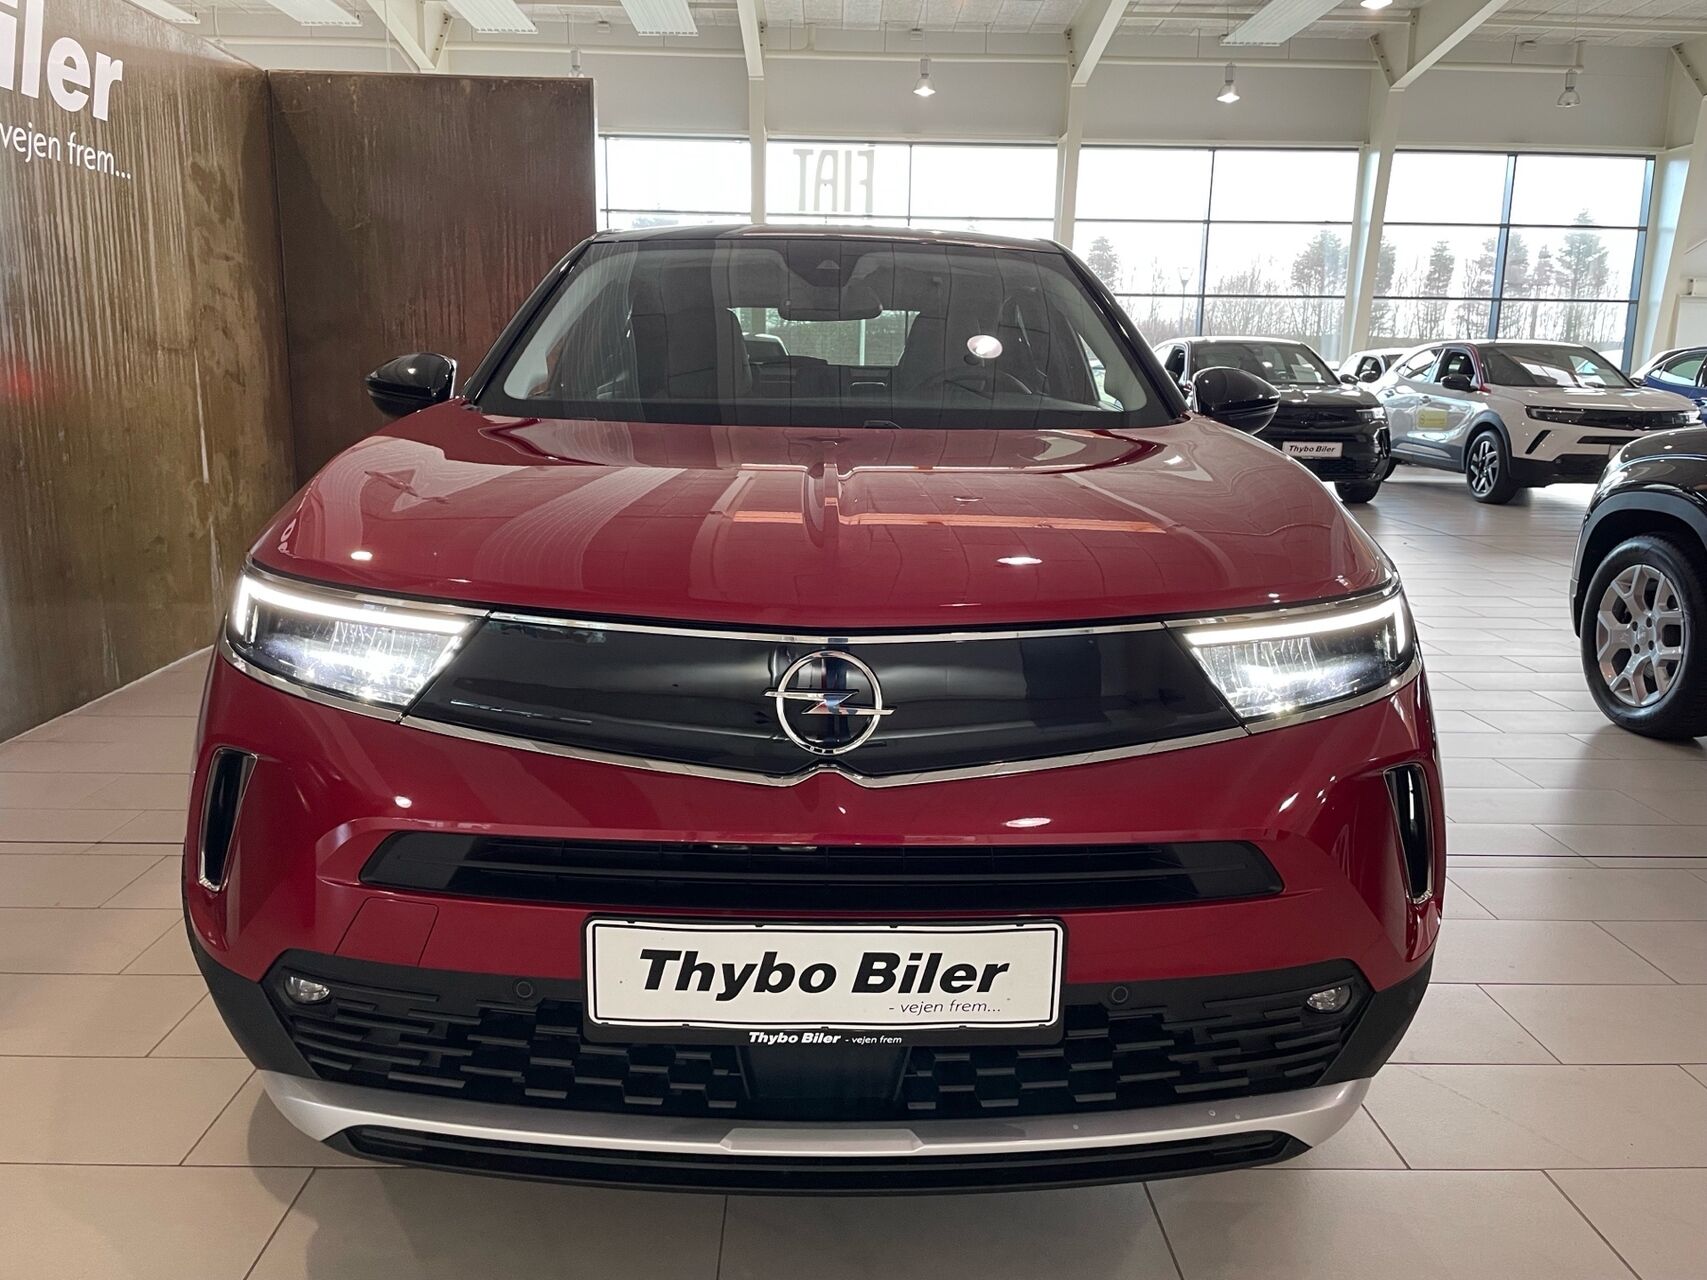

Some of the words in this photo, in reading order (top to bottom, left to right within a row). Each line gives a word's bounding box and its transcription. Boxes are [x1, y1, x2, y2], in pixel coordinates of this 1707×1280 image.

[0, 0, 124, 122] iler
[0, 121, 62, 163] vejen
[67, 131, 132, 180] frem...
[1290, 445, 1315, 453] Thybo
[1315, 445, 1336, 453] Biler
[639, 948, 837, 1002] Thybo
[851, 951, 1011, 994] Biler
[900, 1000, 944, 1016] vejen
[949, 999, 1001, 1013] frem...
[748, 1031, 799, 1046] Thybo
[801, 1032, 842, 1044] Biler
[851, 1035, 877, 1045] vejen
[879, 1034, 903, 1044] frem
